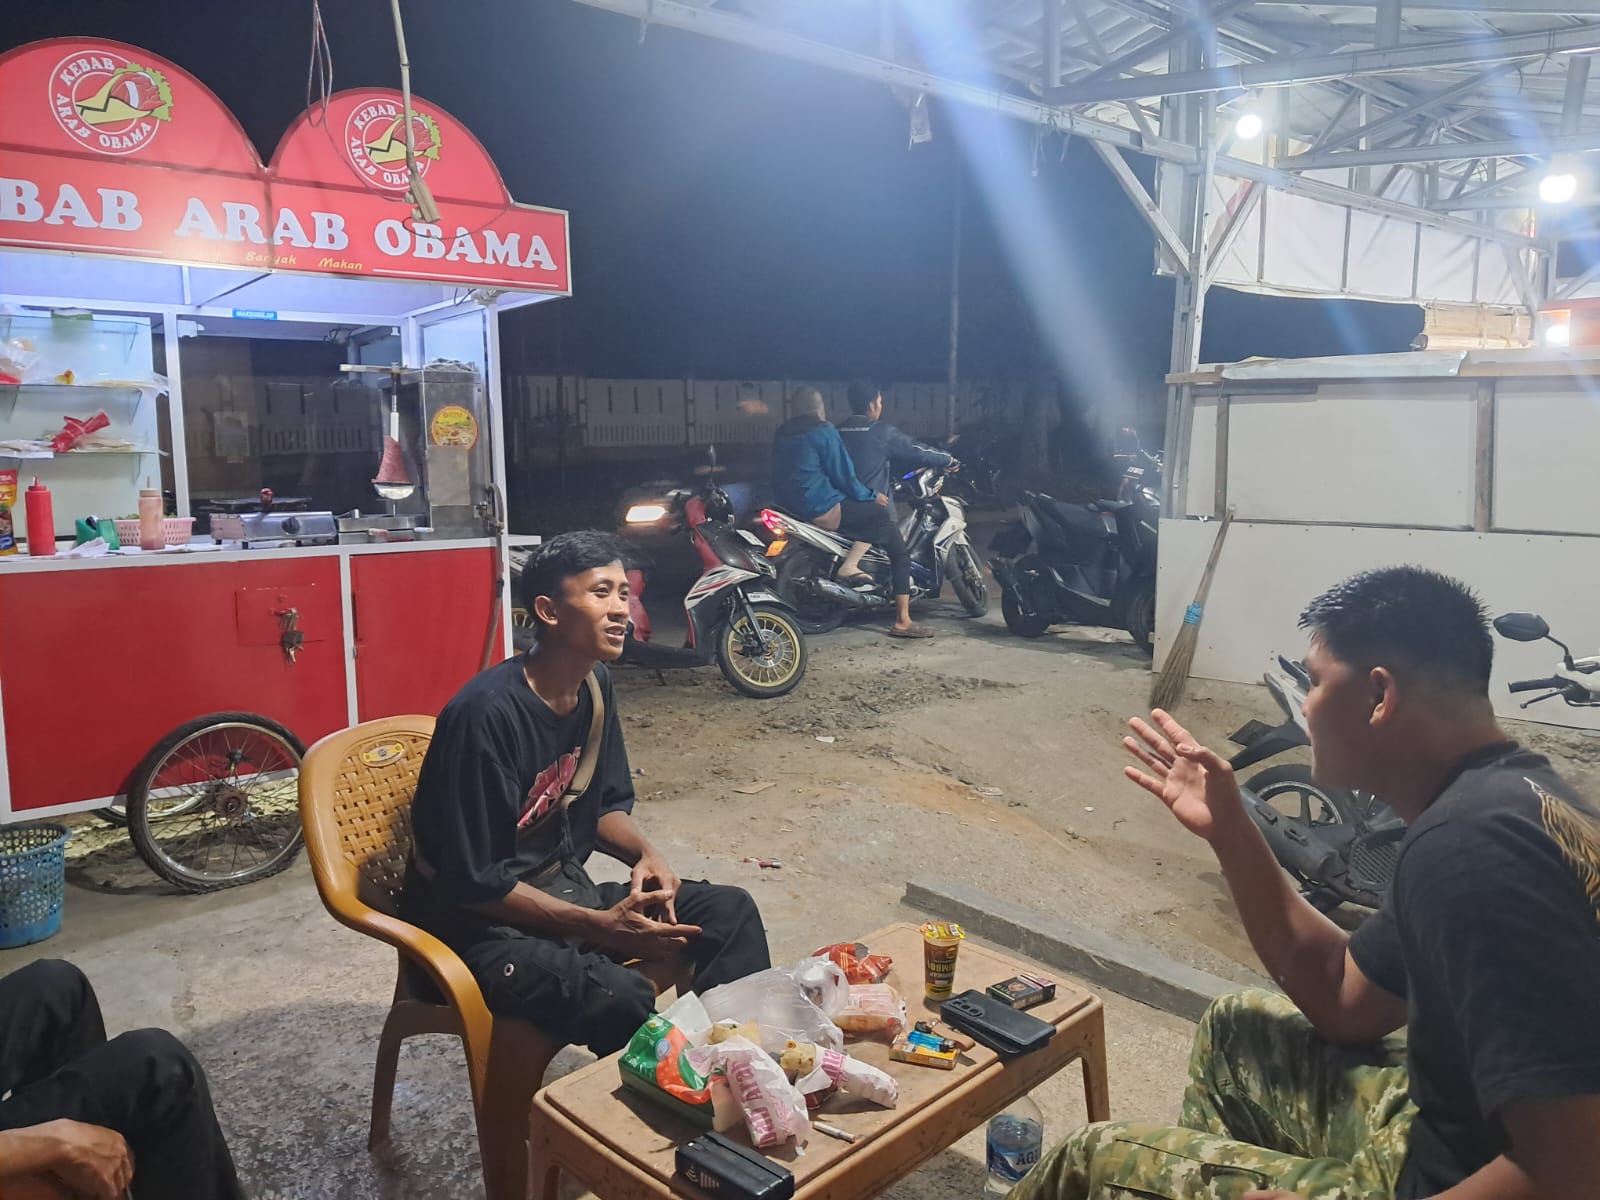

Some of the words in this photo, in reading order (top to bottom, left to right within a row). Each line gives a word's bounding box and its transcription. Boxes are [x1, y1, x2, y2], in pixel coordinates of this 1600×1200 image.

[60, 57, 115, 87] KEBAB
[57, 93, 91, 138] ARAB
[99, 122, 151, 149] OBAMA
[354, 104, 396, 131] KEBAB
[351, 136, 377, 175] ARAB
[383, 161, 424, 185] OBAA
[0, 177, 143, 231] BAB
[174, 197, 349, 251] ARAB
[374, 219, 558, 271] OBAMA
[318, 257, 363, 270] Makan
